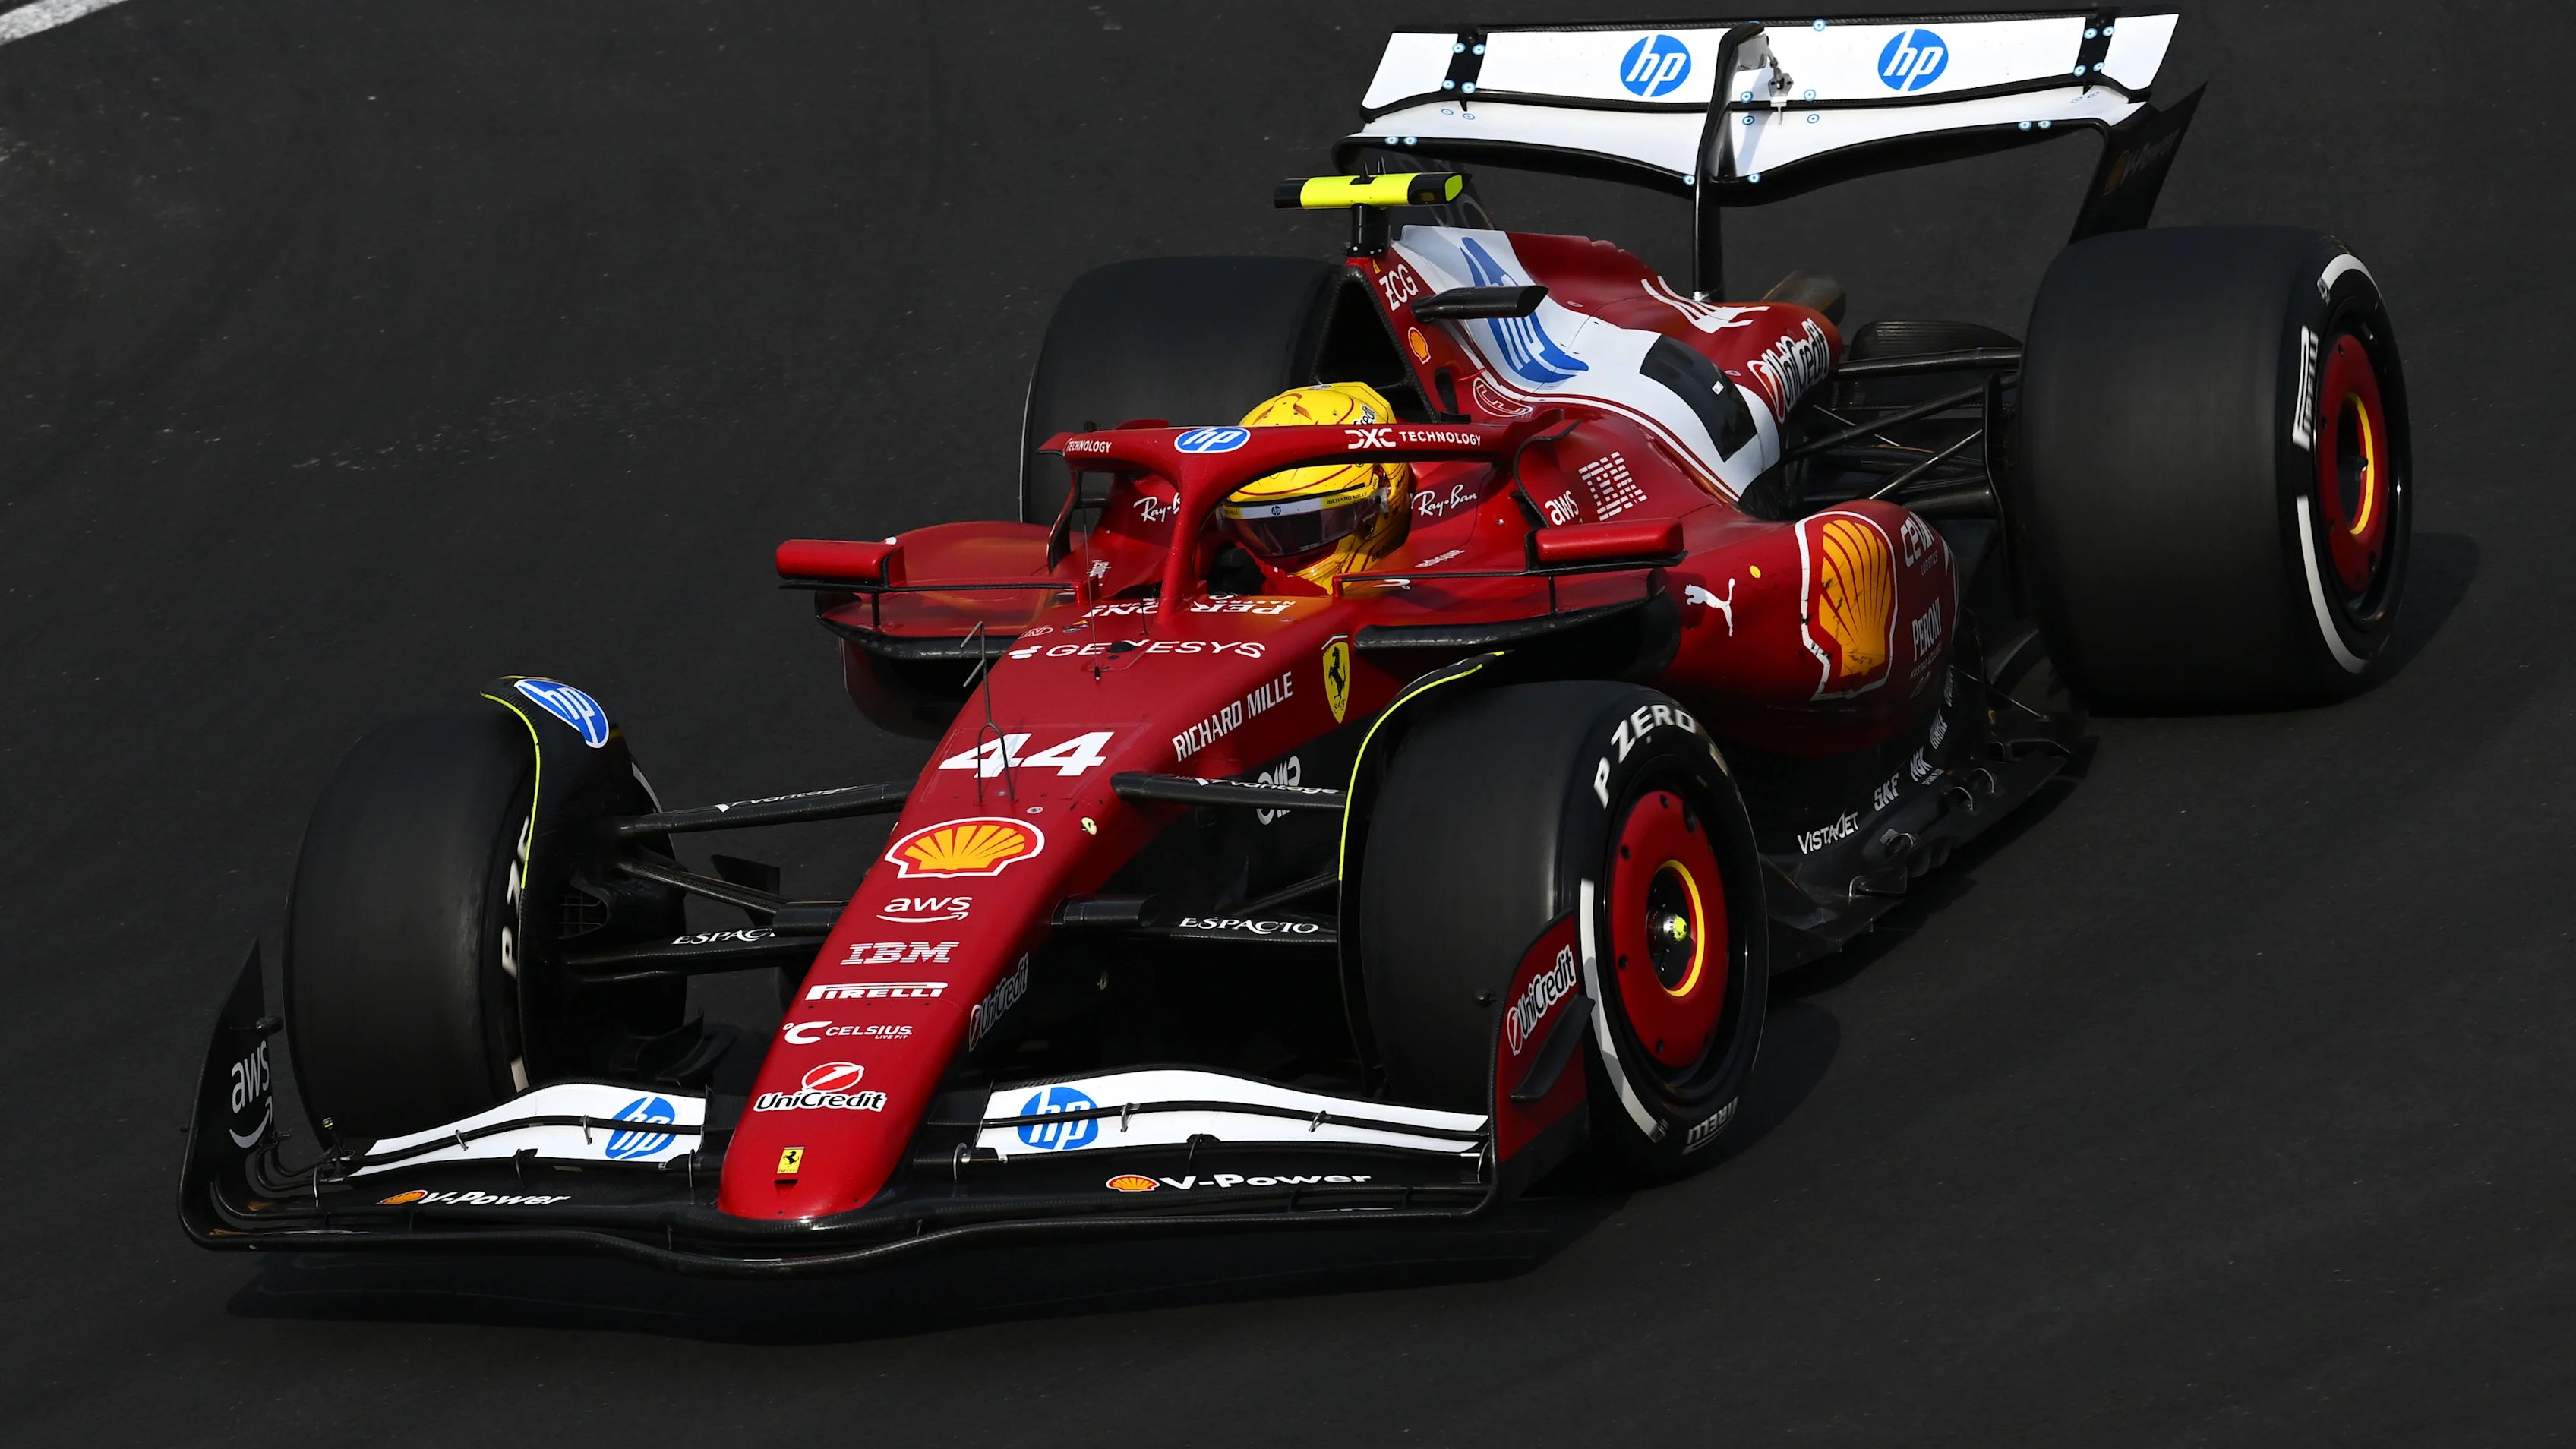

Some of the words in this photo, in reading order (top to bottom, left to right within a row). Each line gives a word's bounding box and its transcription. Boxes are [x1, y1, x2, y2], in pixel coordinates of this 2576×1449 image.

[1624, 34, 1687, 96] hp
[1880, 29, 1945, 91] hp
[1379, 264, 1419, 311] ZCG
[2292, 324, 2319, 452] PIRELLI
[1066, 440, 1112, 453] TECHNOLOGY
[1180, 428, 1245, 453] hp
[1344, 428, 1397, 449] DXC
[1399, 431, 1481, 446] TECHNOLOGY
[1326, 496, 1352, 505] RICHARD
[1413, 485, 1477, 516] Ray-Ban
[1578, 451, 1648, 522] IBM
[1134, 493, 1180, 522] Ray-B
[1271, 506, 1281, 516] hp
[1544, 490, 1581, 526] aws
[1911, 597, 1942, 662] PERONI
[515, 679, 605, 747] hp
[1172, 699, 1243, 762] RICHARD
[1248, 671, 1293, 720] MILLE
[938, 731, 1114, 778] 44
[1594, 756, 1611, 809] P
[1611, 703, 1697, 763] ZERO
[1910, 746, 1933, 782] NGK
[1231, 781, 1339, 794] vantage
[1874, 772, 1899, 812] SKF
[883, 896, 973, 914] aws
[671, 927, 775, 945] ESPAC
[840, 941, 960, 965] IBM
[804, 982, 949, 1001] PIRELLI
[980, 952, 1029, 1039] UniCredit
[1517, 944, 1577, 1039] UniCredit
[825, 1025, 912, 1037] CELSIUS
[231, 1040, 270, 1114] aws
[755, 1091, 886, 1112] UniCredit
[1022, 1086, 1094, 1150] hp
[608, 1097, 673, 1160] hp
[422, 1190, 570, 1204] V-Power
[1159, 1173, 1372, 1191] V-Power
